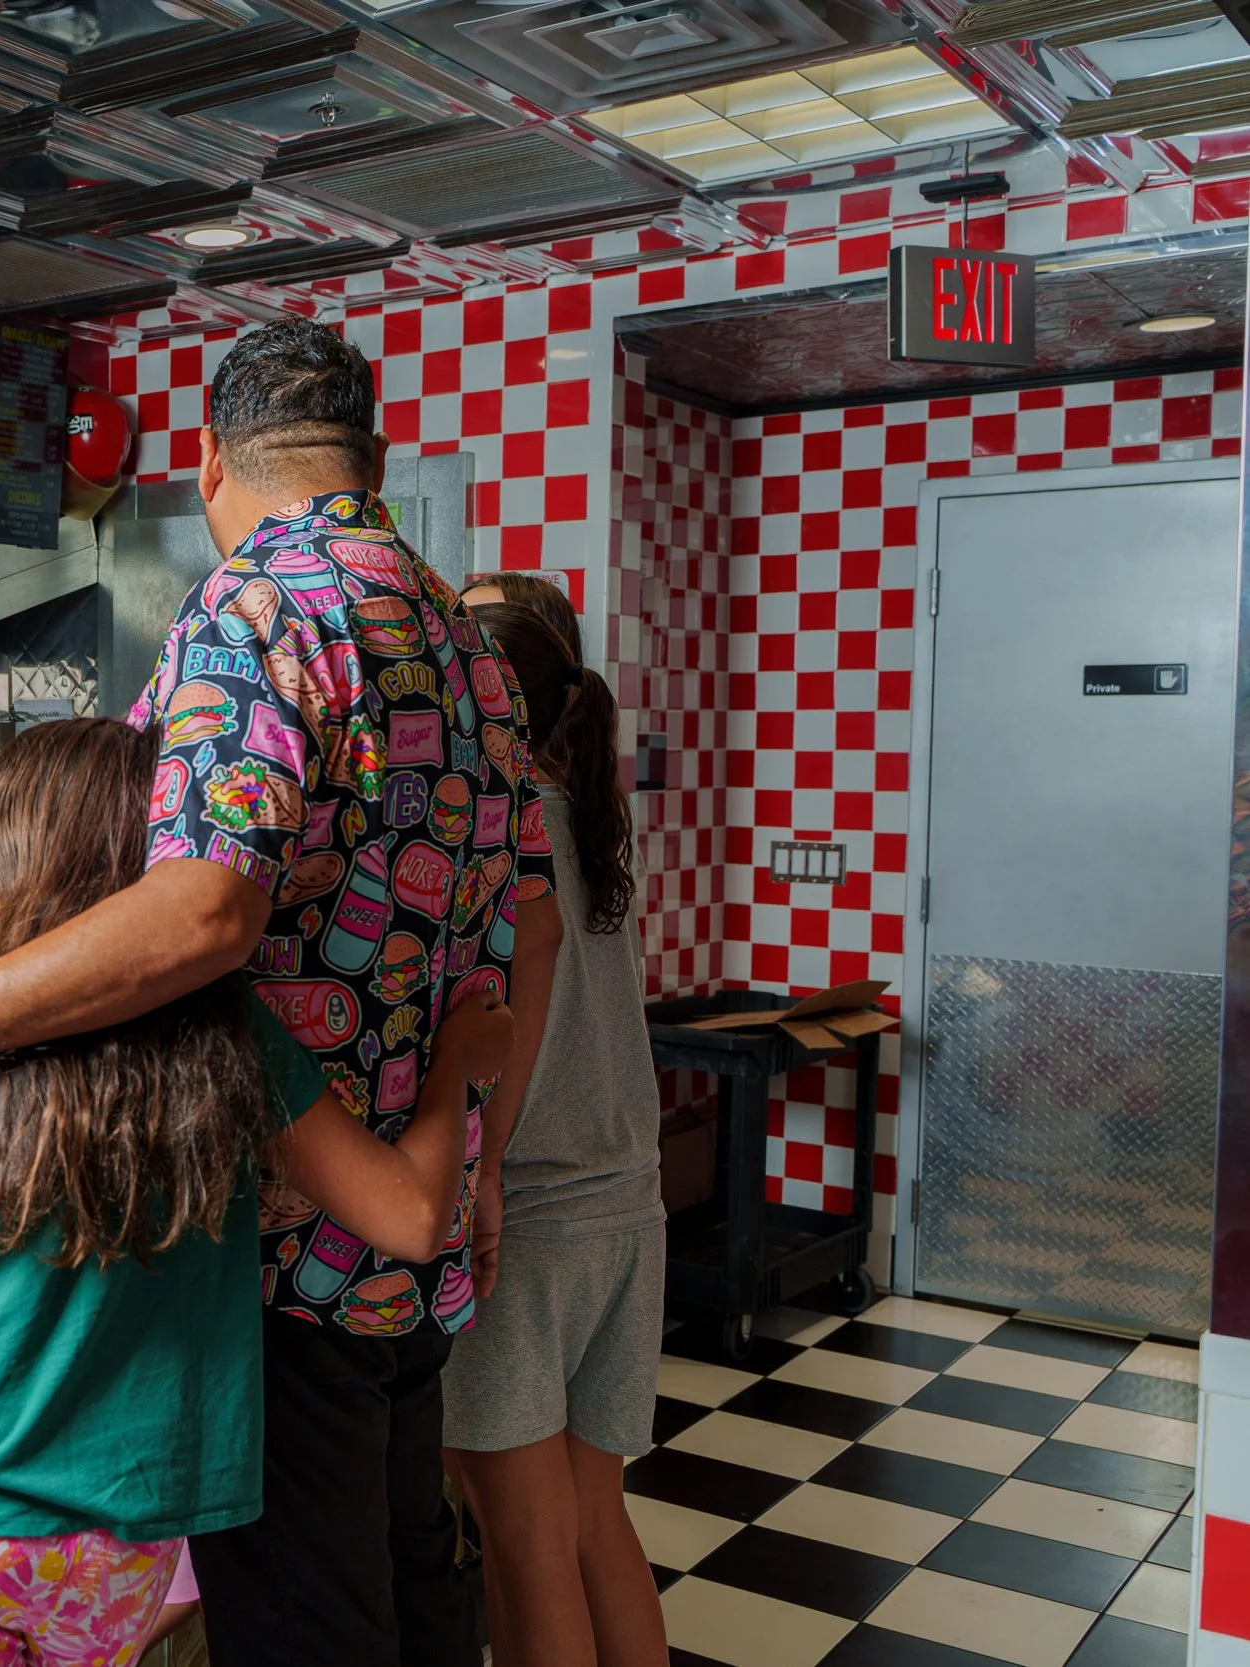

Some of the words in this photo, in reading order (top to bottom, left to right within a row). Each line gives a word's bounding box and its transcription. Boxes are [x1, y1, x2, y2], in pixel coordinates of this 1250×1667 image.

[933, 257, 1018, 345] EXIT
[1086, 684, 1120, 693] Private
[397, 726, 433, 750] Sugar
[482, 809, 505, 831] Sugar
[339, 904, 384, 930] SWEET
[316, 1235, 360, 1261] SWEET
